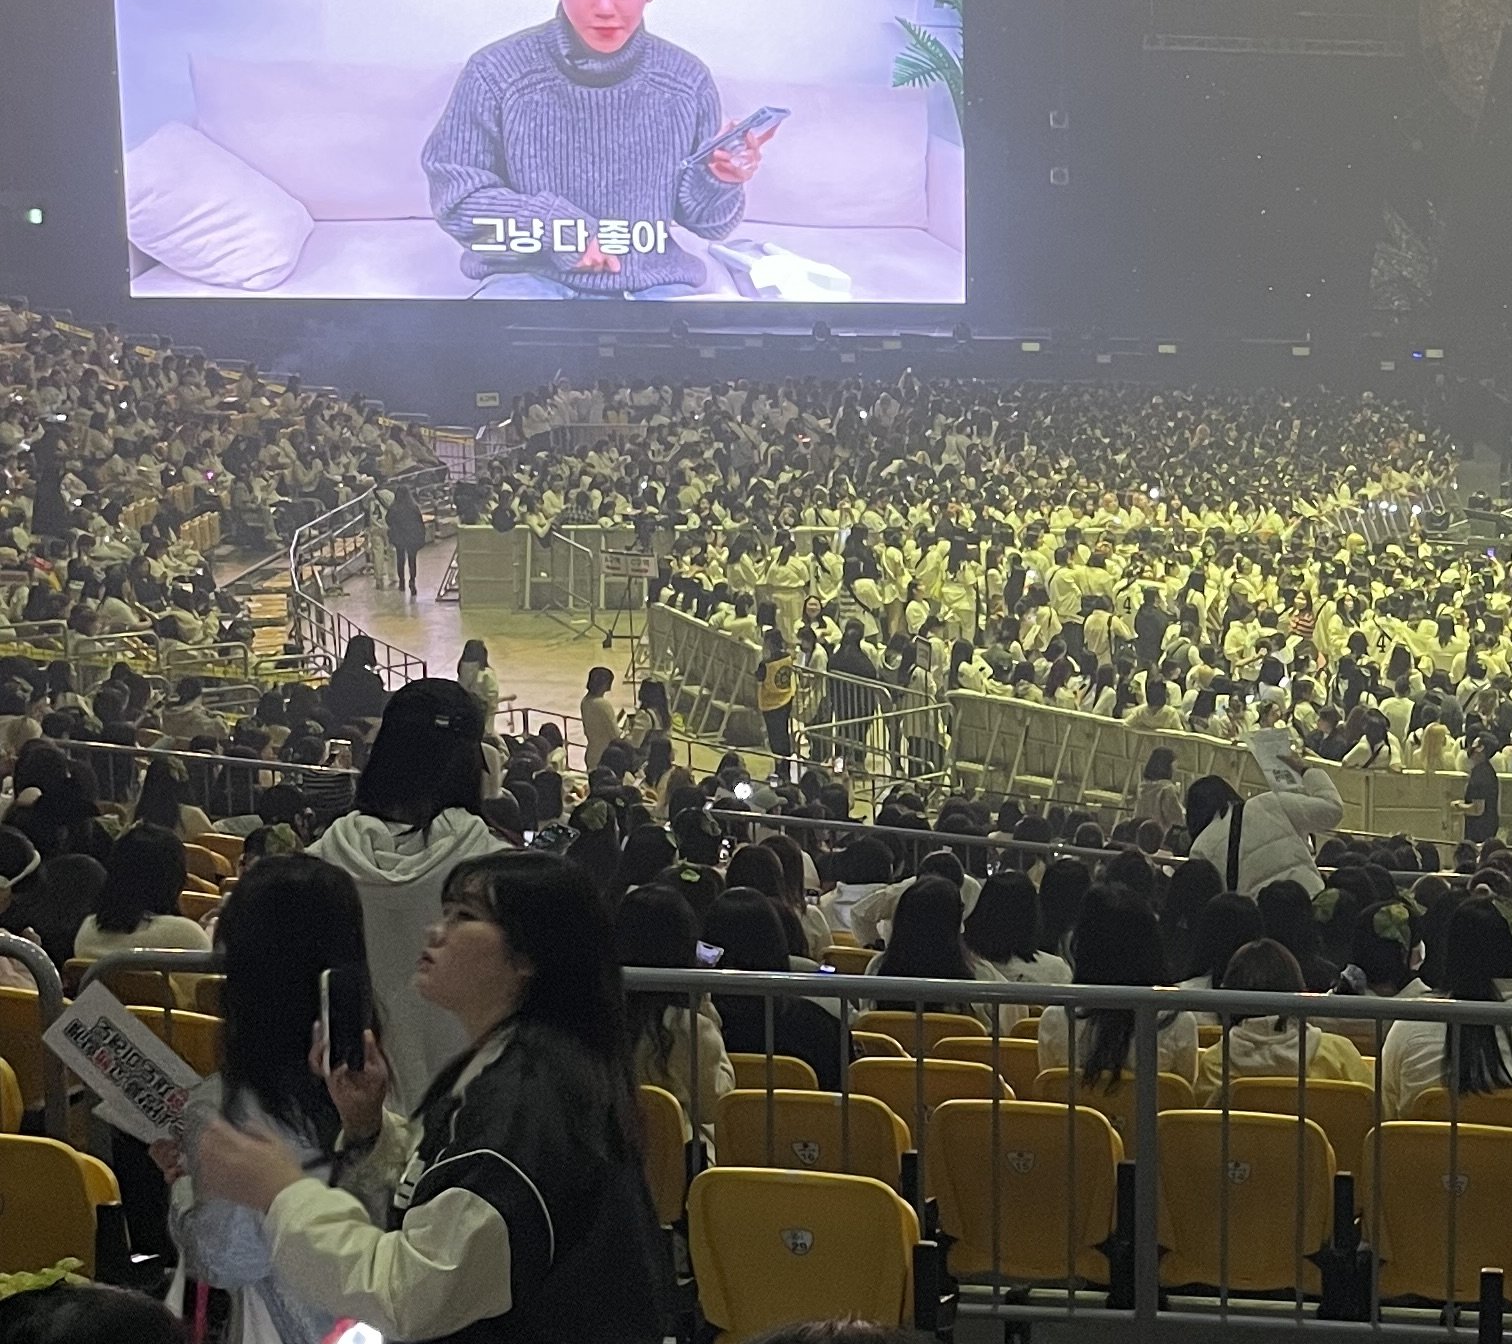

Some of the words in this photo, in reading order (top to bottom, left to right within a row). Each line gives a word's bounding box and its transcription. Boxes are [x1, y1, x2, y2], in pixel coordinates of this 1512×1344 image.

[471, 218, 545, 253] 그냥
[553, 219, 588, 253] 다
[597, 220, 667, 254] 좋아
[1376, 634, 1387, 653] 4
